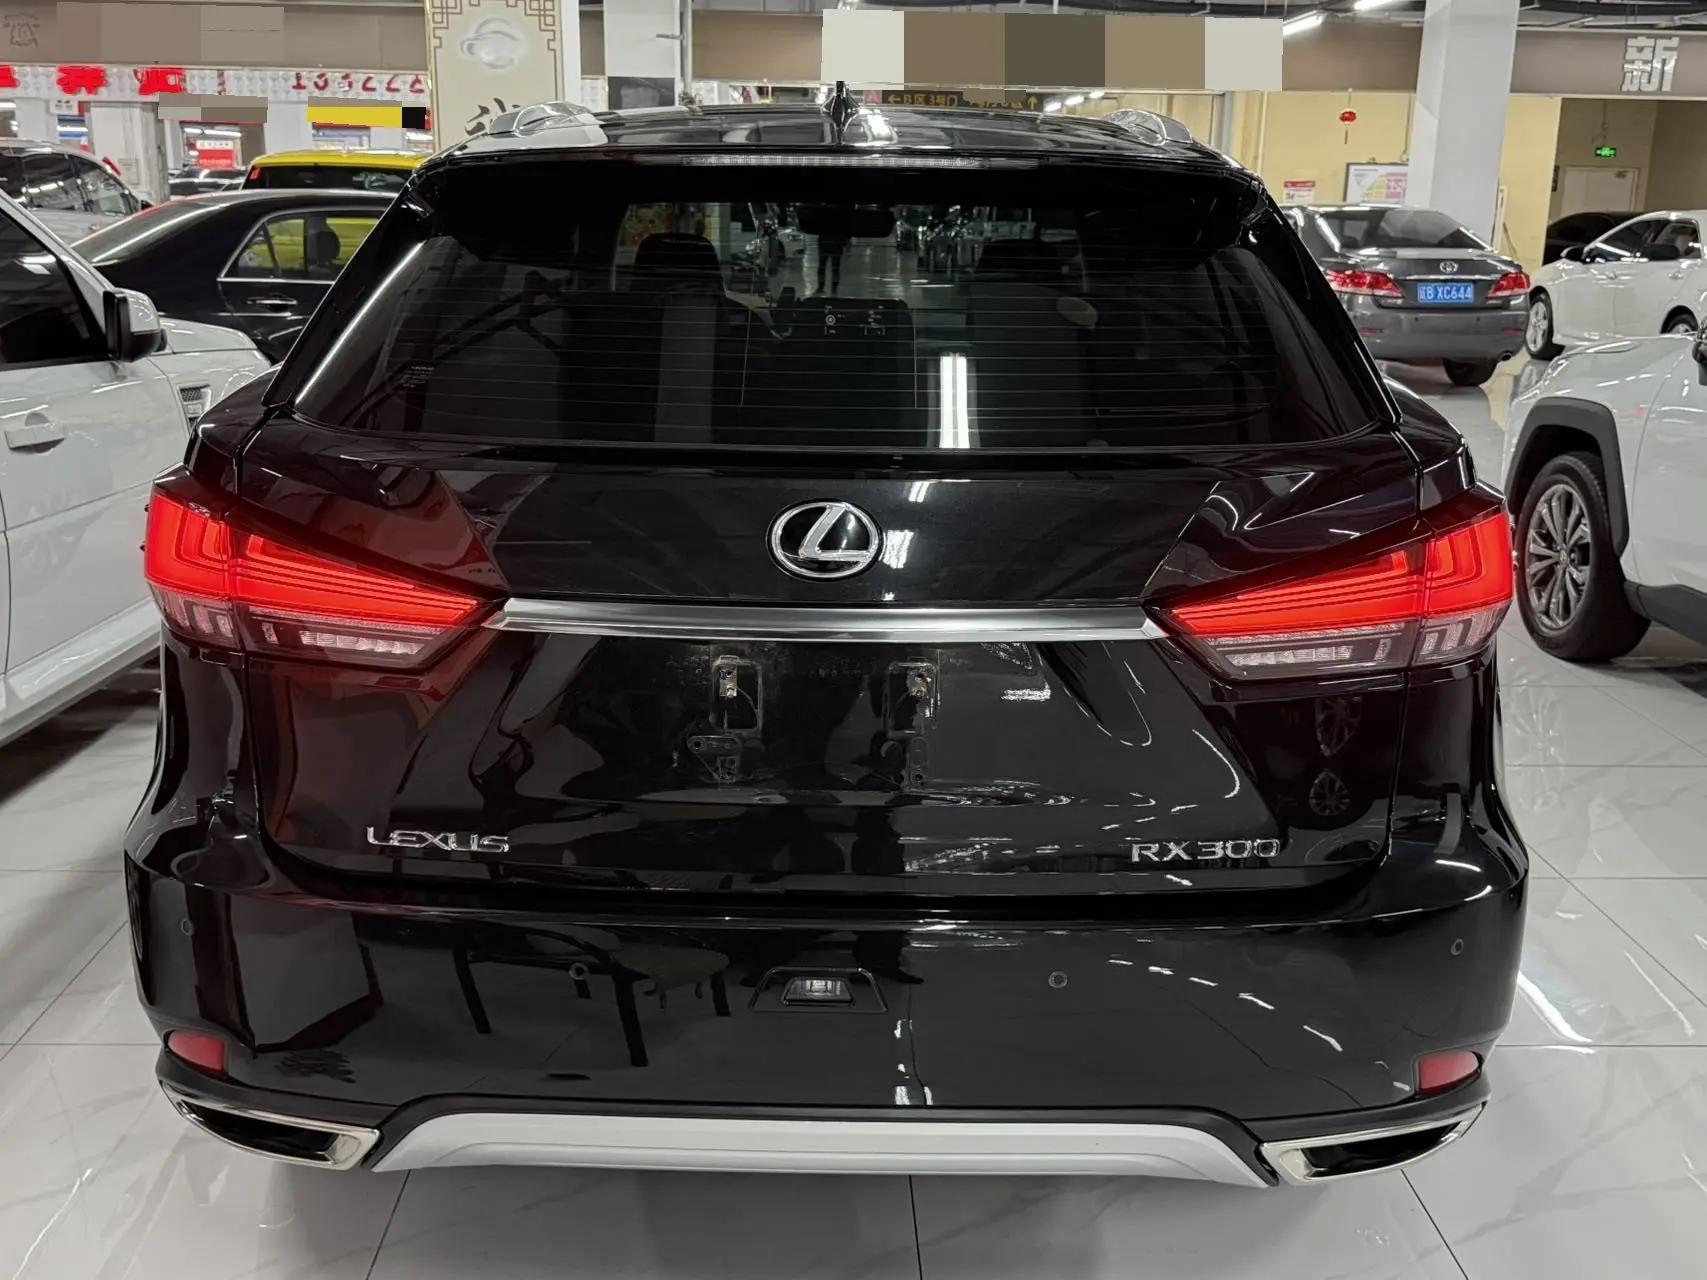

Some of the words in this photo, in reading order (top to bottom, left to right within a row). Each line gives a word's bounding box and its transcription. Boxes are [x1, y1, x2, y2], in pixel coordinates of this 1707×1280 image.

[1621, 36, 1680, 92] 新
[366, 826, 510, 853] LEXUS
[1131, 840, 1193, 863] RX
[1197, 838, 1281, 860] 300
